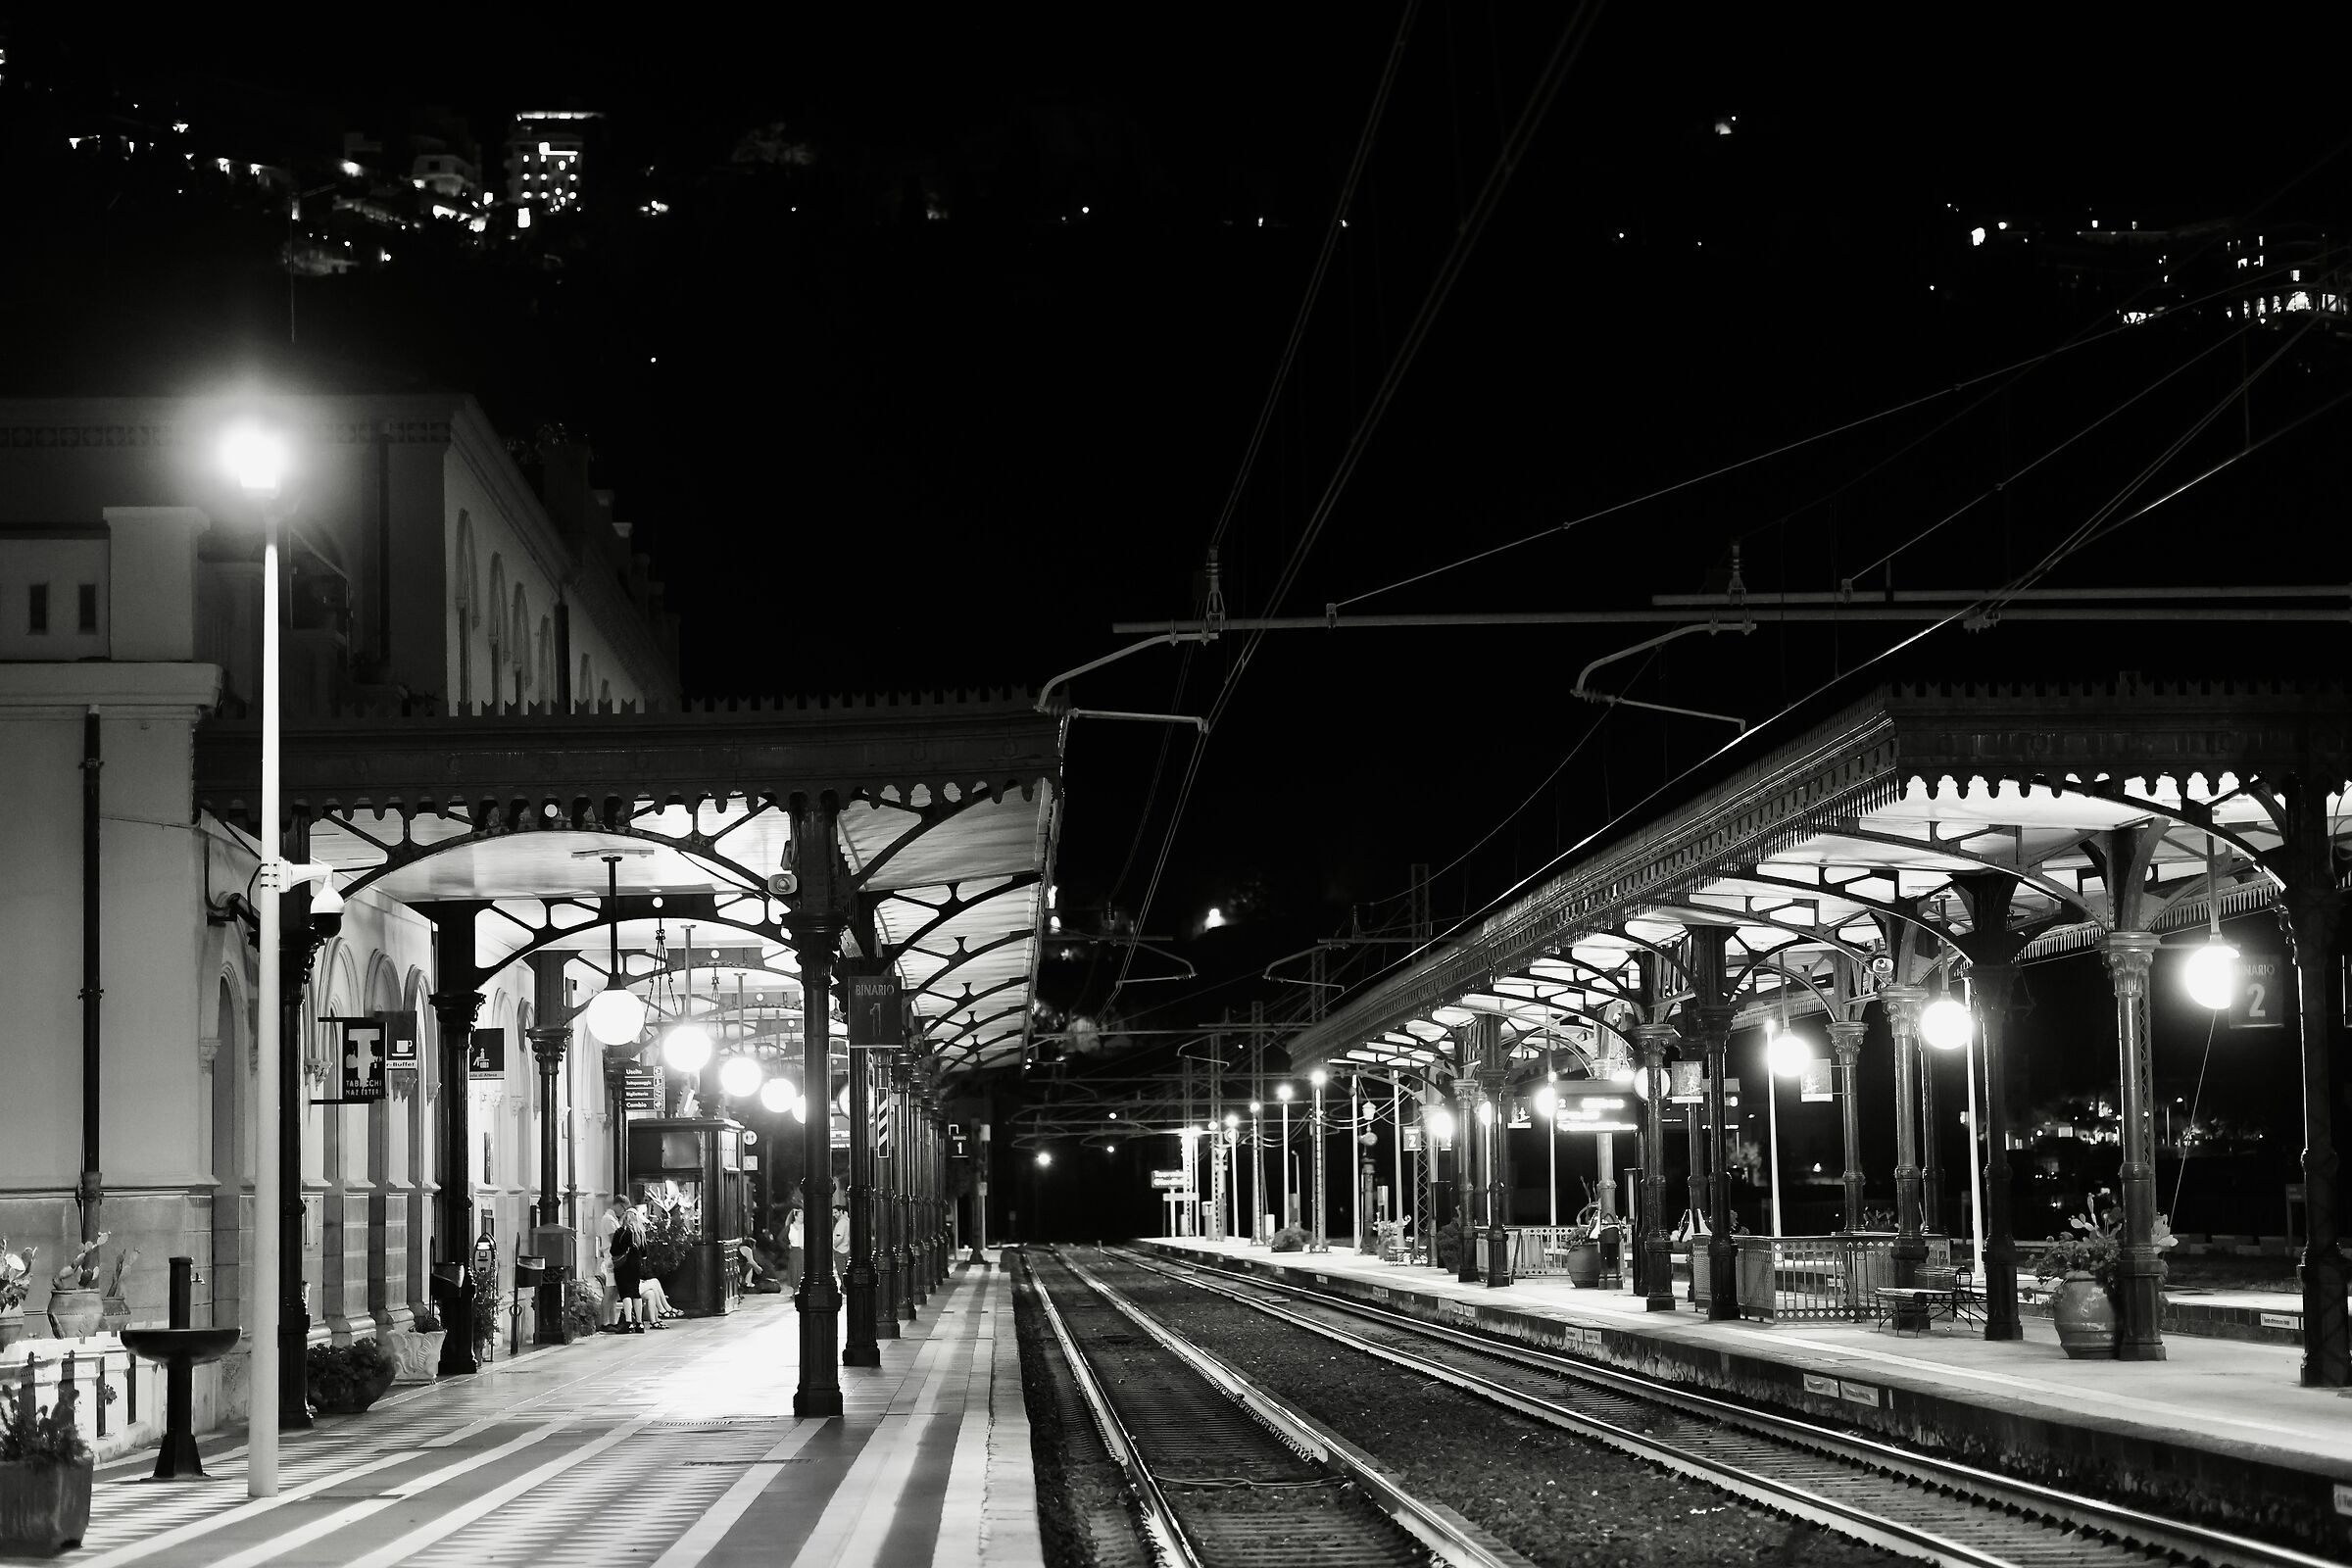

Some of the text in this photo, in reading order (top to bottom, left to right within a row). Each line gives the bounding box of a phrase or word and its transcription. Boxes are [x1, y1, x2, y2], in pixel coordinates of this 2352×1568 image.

[856, 984, 895, 996] BINARIO
[2247, 983, 2267, 1017] 2
[870, 1003, 881, 1037] 1
[348, 1028, 380, 1088] T
[957, 1142, 962, 1154] 1
[1408, 1135, 1417, 1148] 2
